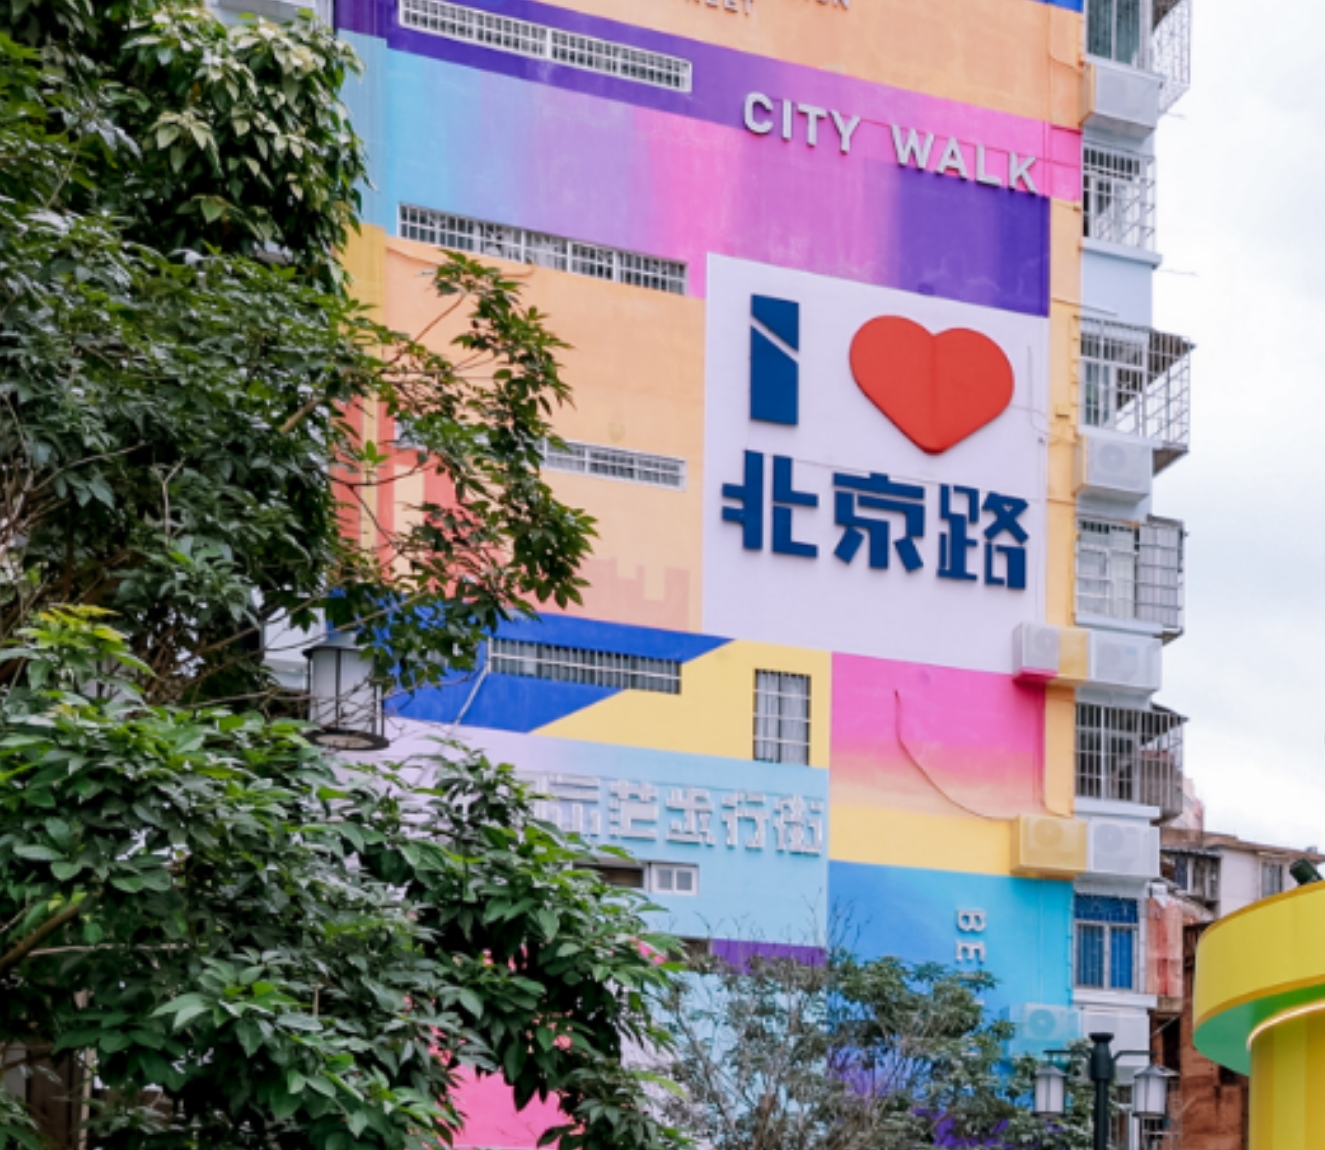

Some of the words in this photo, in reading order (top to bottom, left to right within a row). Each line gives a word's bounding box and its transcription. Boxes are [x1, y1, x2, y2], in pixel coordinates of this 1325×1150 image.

[743, 91, 861, 154] CITY
[891, 125, 1039, 193] WALK
[749, 293, 800, 427] I
[721, 450, 1030, 590] 北京路
